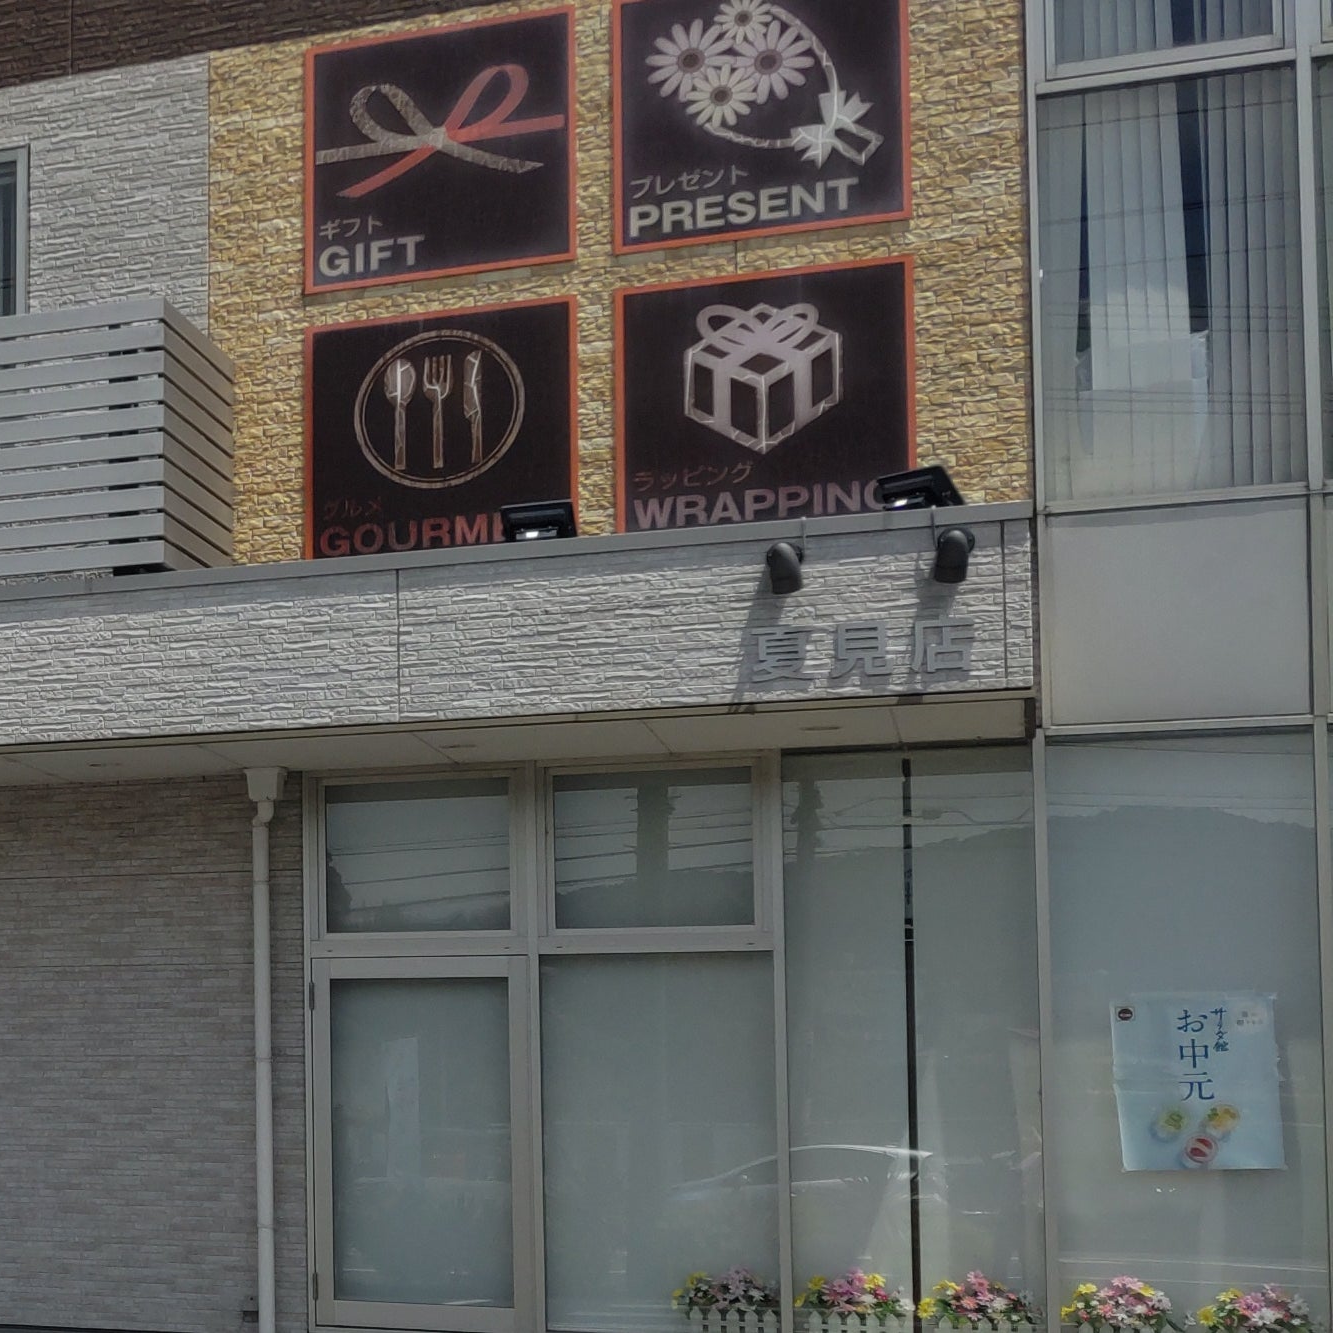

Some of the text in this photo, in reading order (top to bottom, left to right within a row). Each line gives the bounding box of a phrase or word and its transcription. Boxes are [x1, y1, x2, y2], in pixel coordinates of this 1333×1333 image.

[629, 166, 748, 198] プレゼント
[318, 214, 383, 241] ギフト
[628, 177, 859, 237] PRESENT
[318, 234, 425, 278] GIFT
[634, 460, 754, 492] ラッピング
[318, 511, 506, 557] GOURM
[751, 617, 974, 682] 夏見店
[1176, 1010, 1215, 1101] お中元
